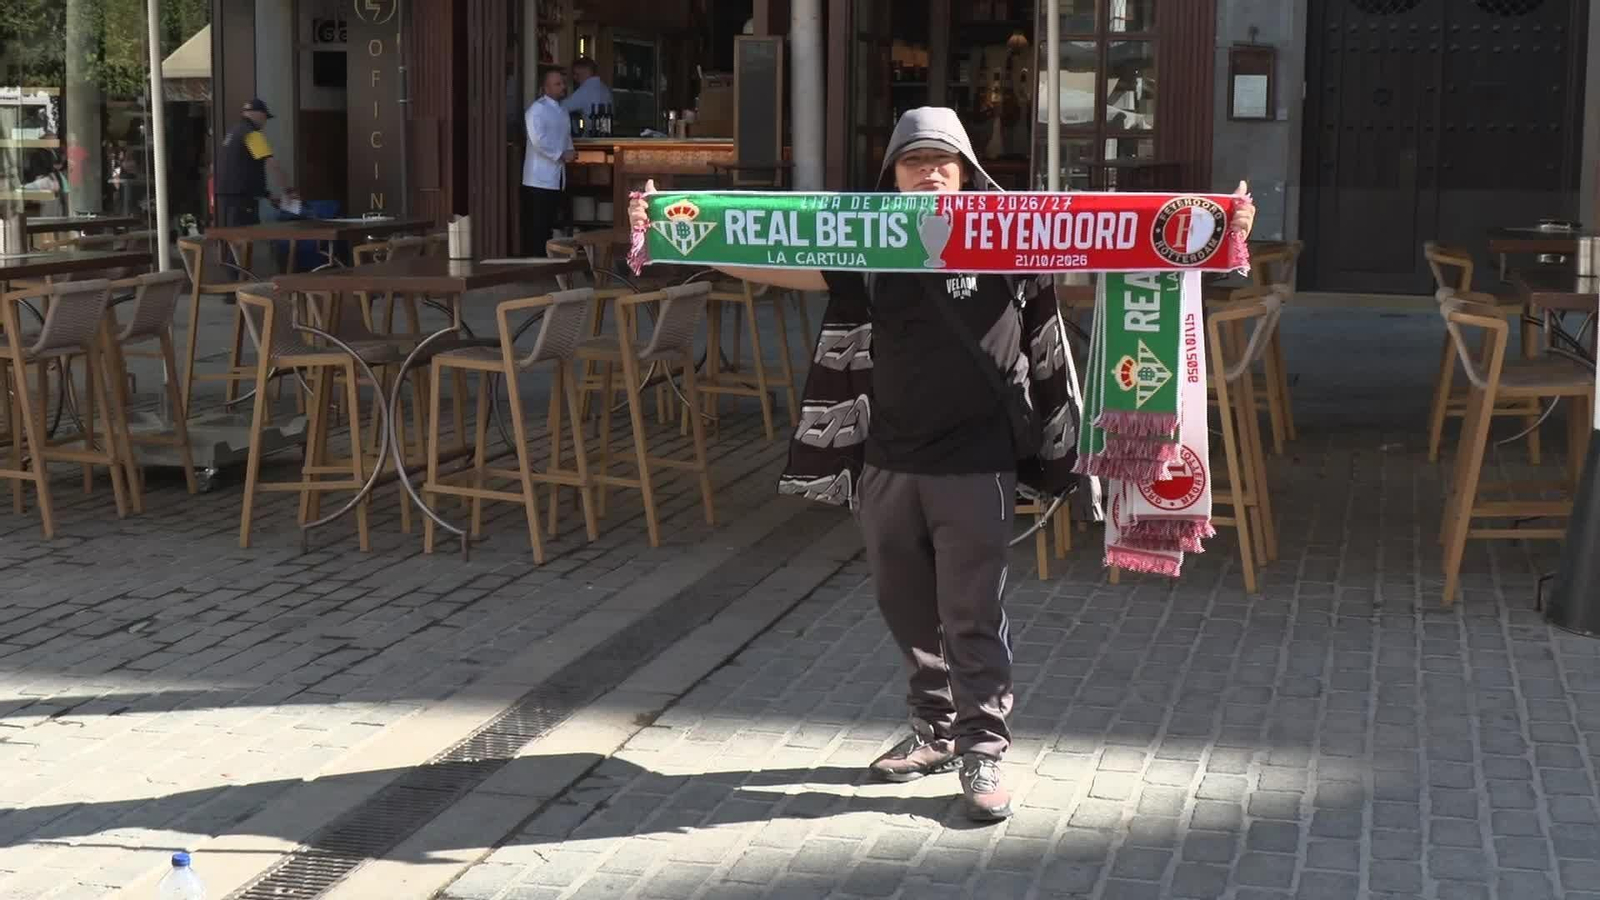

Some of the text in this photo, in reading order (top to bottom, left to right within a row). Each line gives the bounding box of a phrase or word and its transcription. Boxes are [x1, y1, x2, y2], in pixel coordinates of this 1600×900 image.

[801, 196, 1072, 210] LIGA DE CAMPEONES 2026/27
[724, 208, 908, 249] REAL BETIS
[964, 211, 1138, 250] FEYENOORD
[767, 251, 867, 266] LA CARTUJA
[1015, 254, 1087, 267] 21/10/2026
[1156, 238, 1218, 264] ROTTERDAM
[1124, 272, 1161, 332] REA
